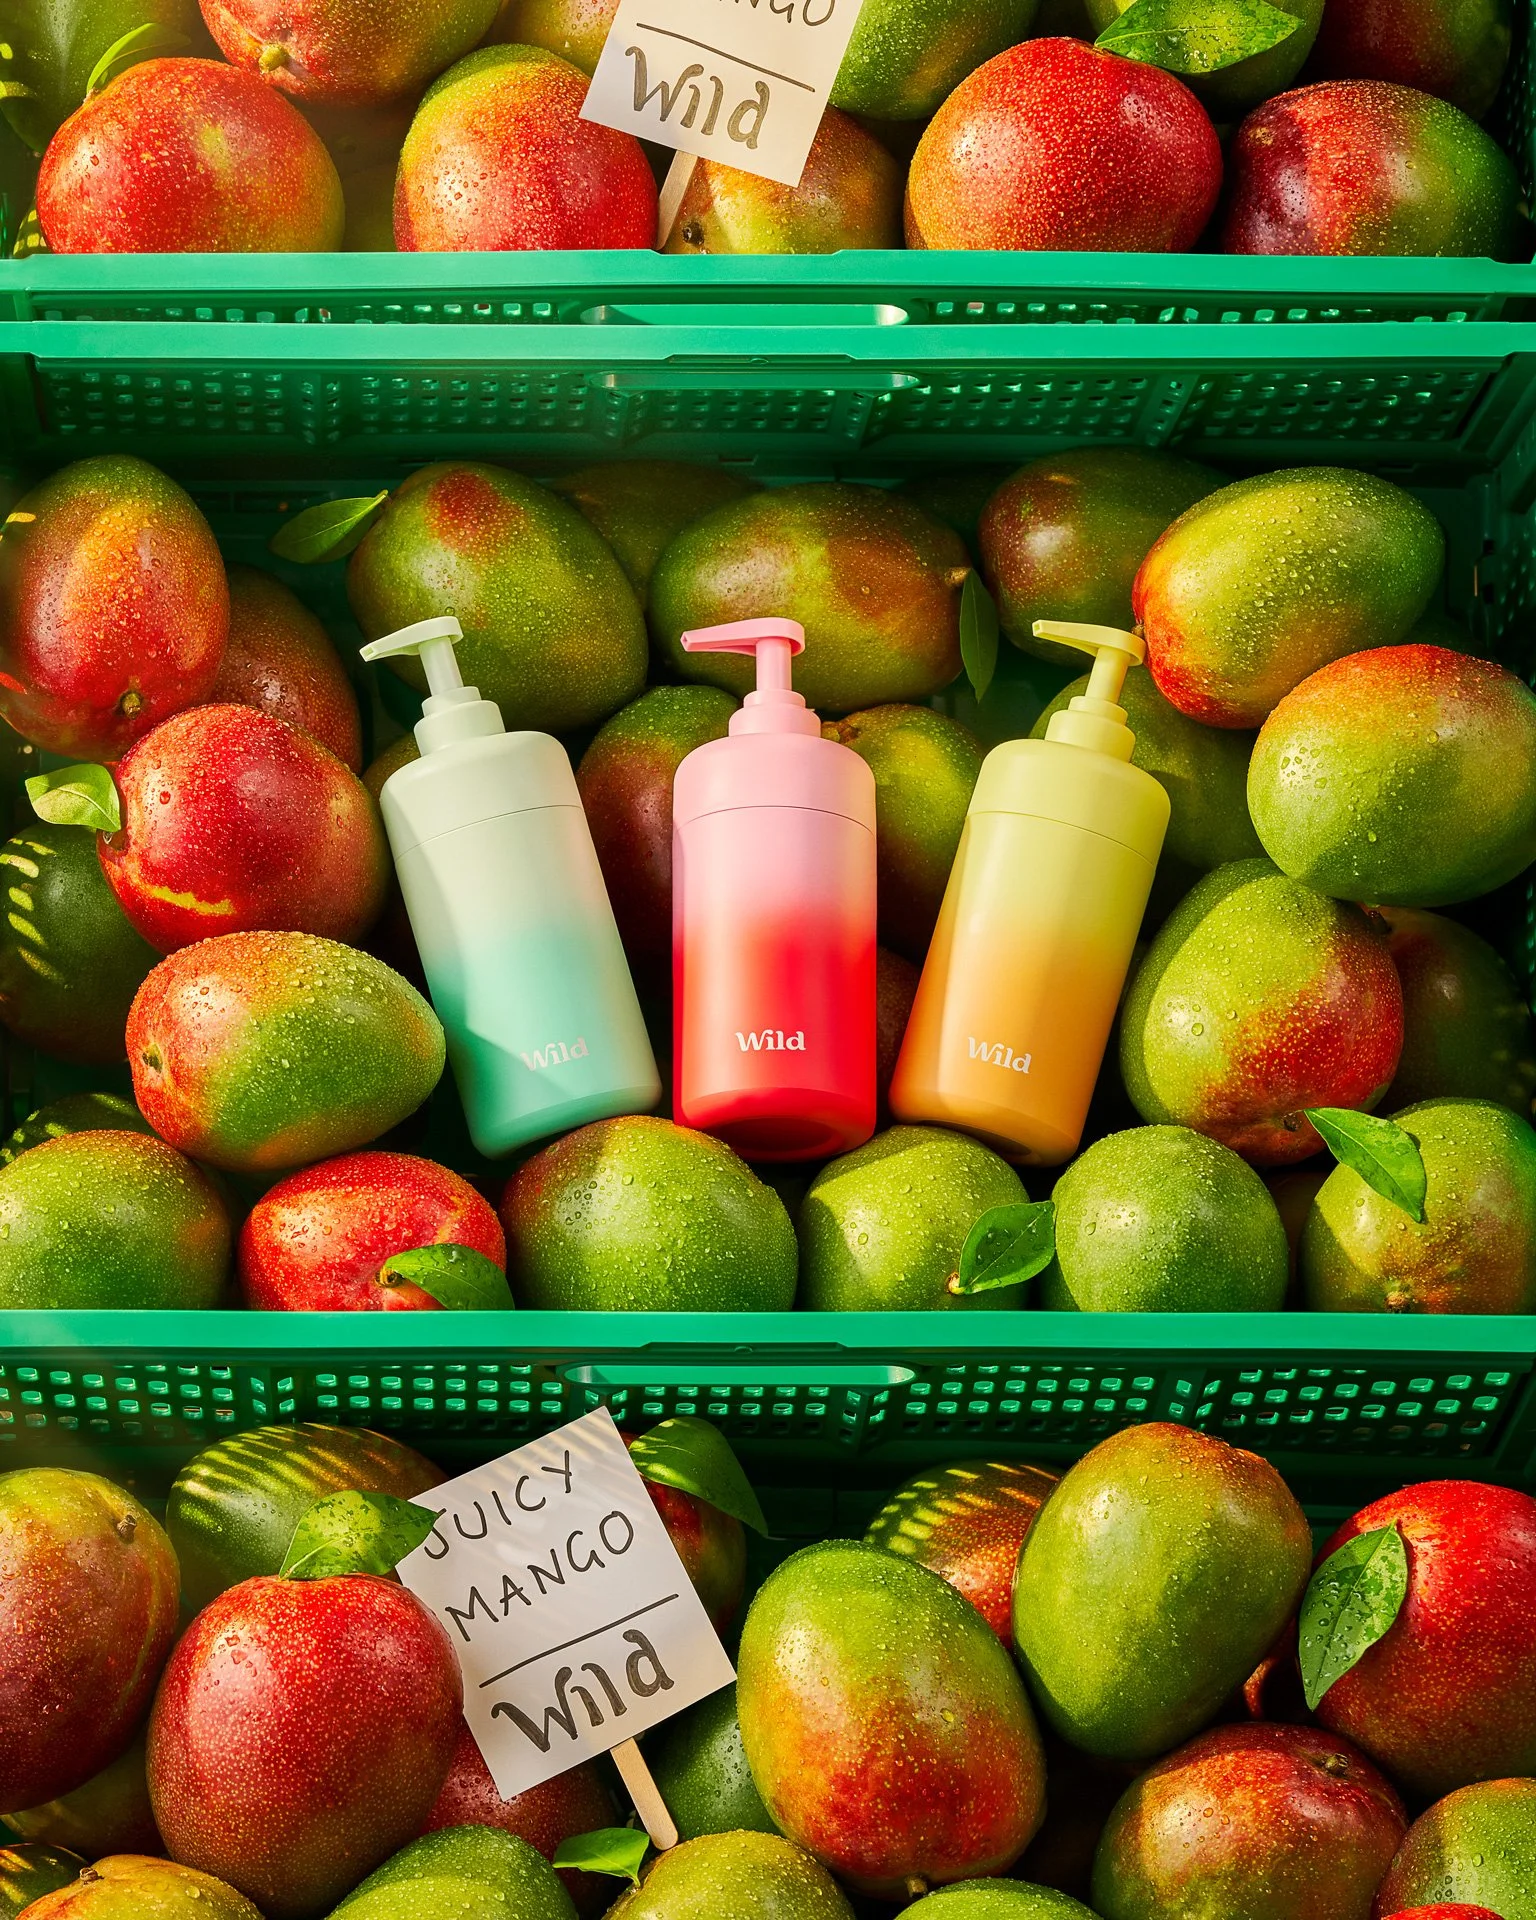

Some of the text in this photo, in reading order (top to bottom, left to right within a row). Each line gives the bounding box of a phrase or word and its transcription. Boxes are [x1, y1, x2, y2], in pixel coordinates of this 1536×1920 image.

[625, 46, 770, 149] Wild
[520, 1036, 590, 1071] Wild
[736, 1029, 807, 1052] Wild
[968, 1037, 1032, 1073] Wild
[424, 1450, 572, 1559] JUICY
[445, 1511, 634, 1641] MANGO
[491, 1629, 674, 1752] Wild
